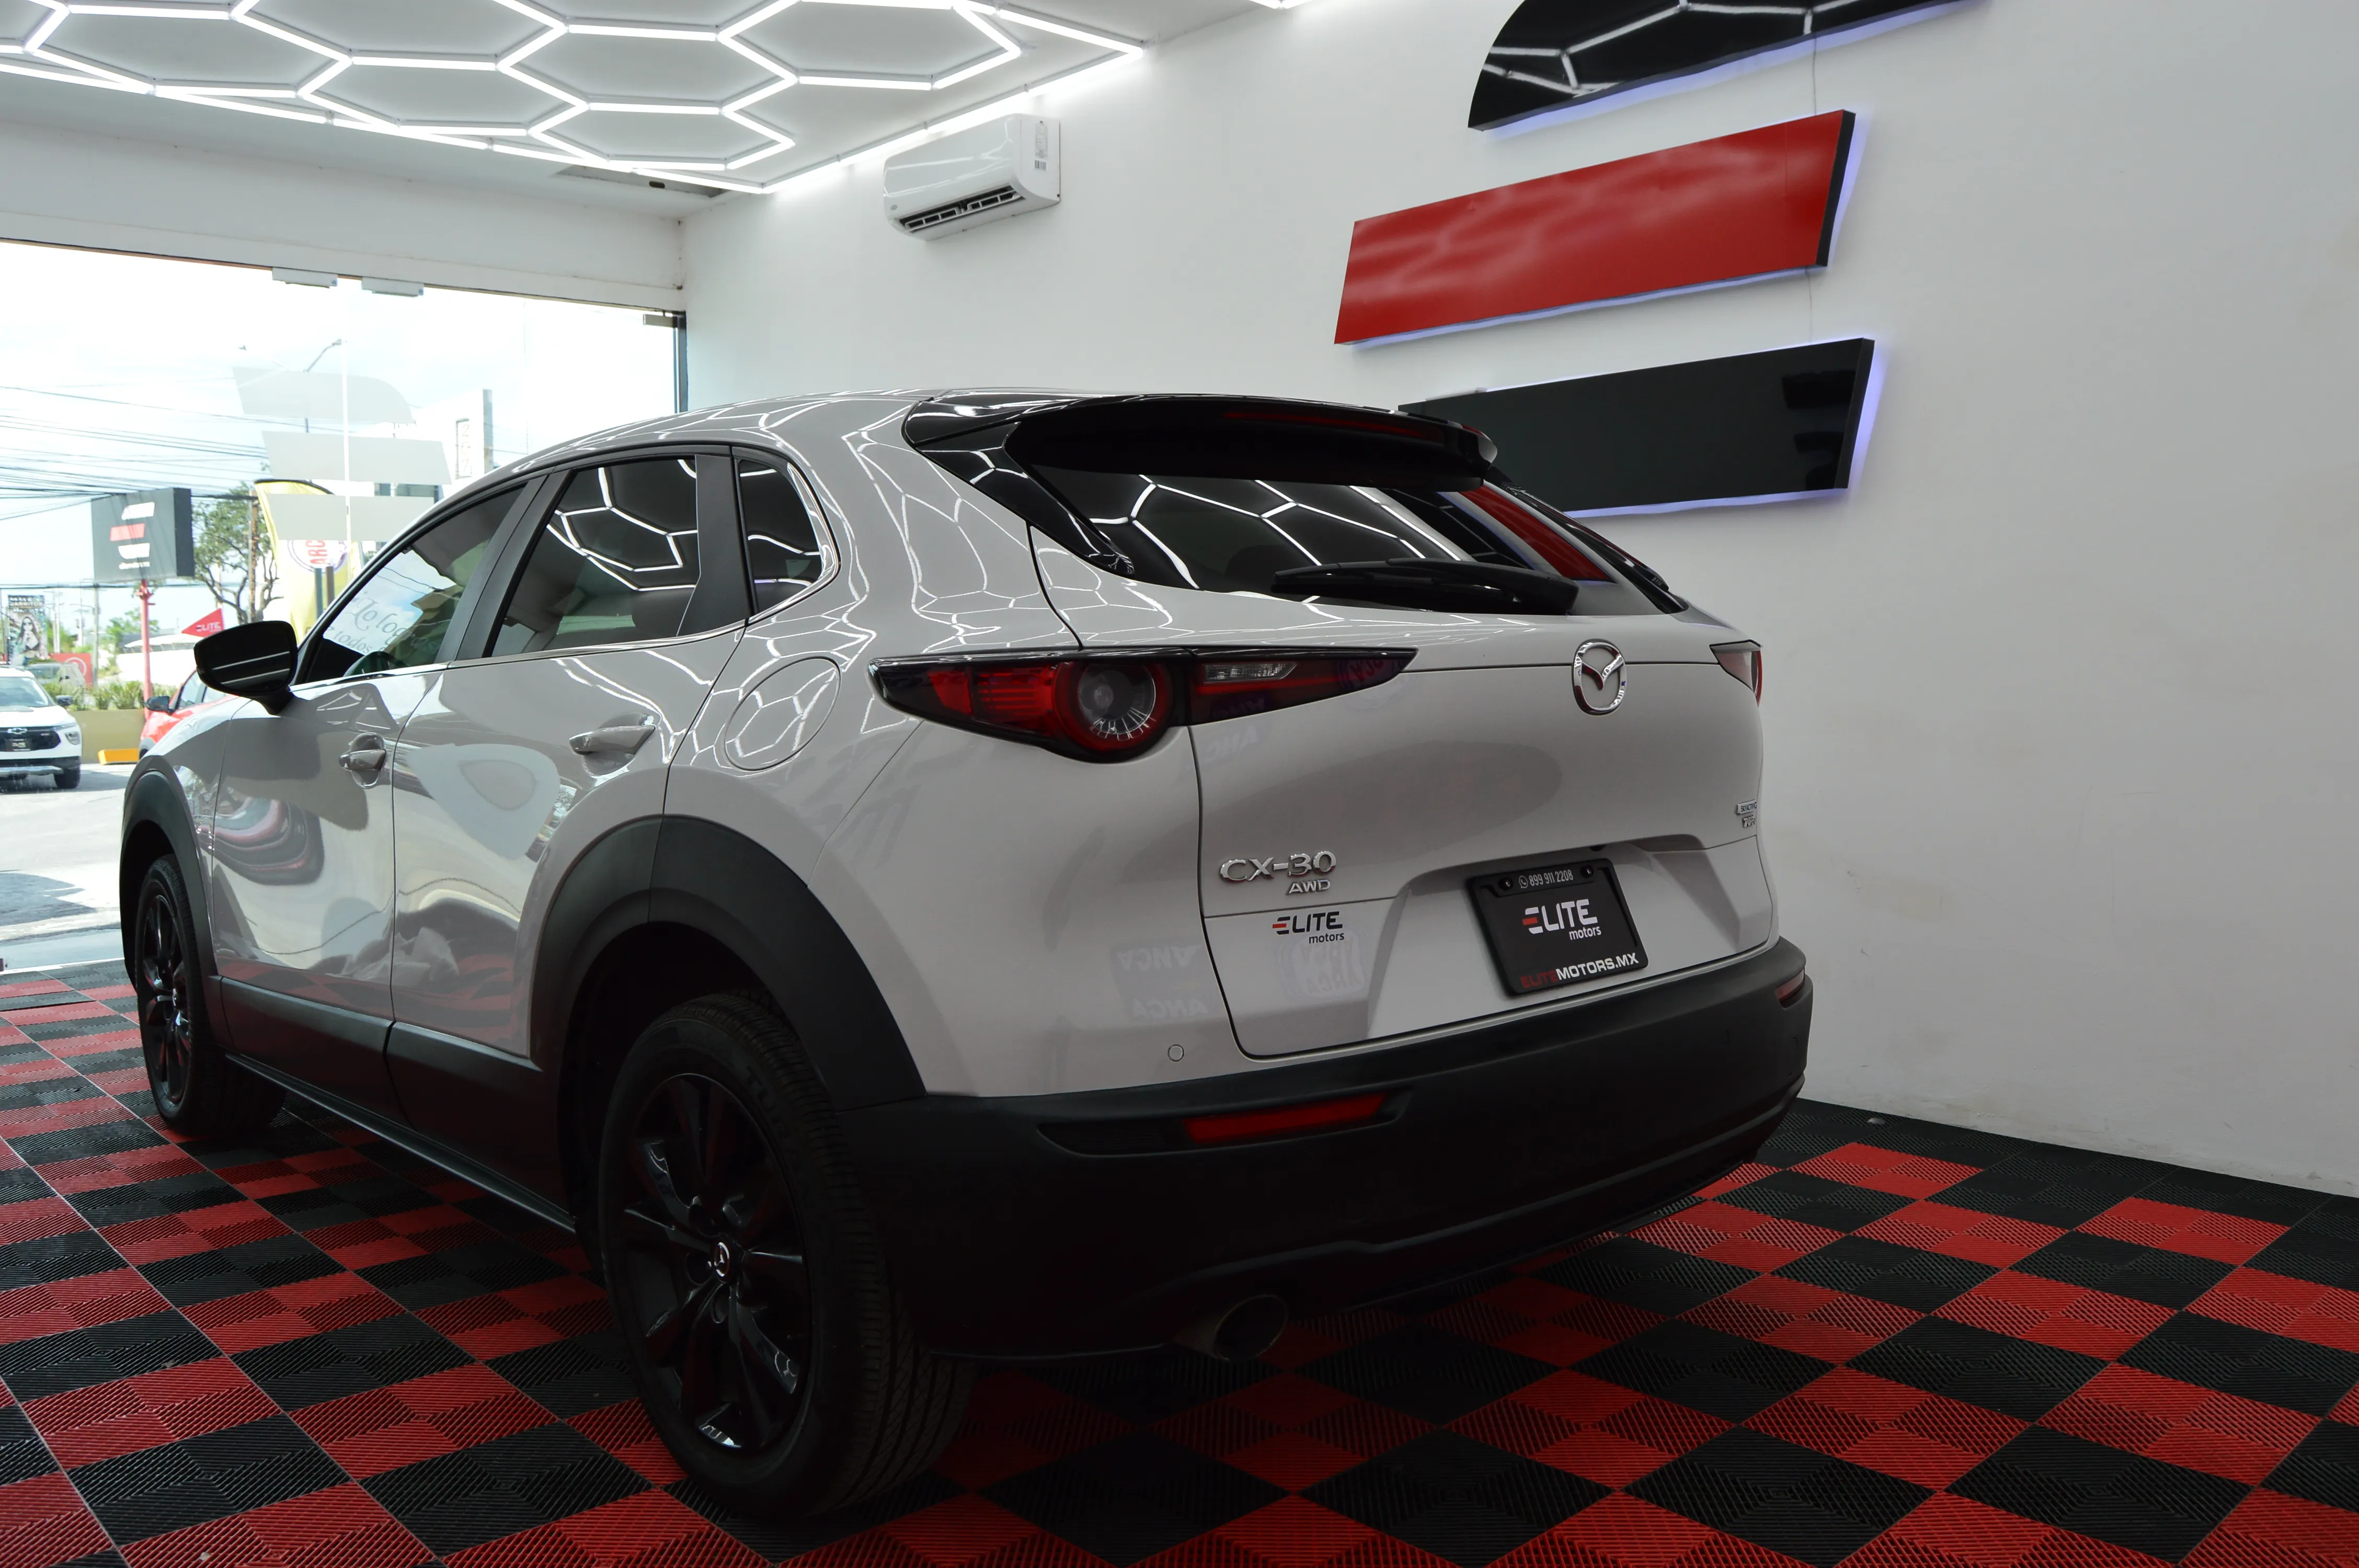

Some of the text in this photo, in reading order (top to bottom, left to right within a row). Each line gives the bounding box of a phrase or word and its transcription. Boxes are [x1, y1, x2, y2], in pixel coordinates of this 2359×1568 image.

[1219, 850, 1337, 883] CX-30
[1286, 879, 1331, 895] AWD
[1529, 870, 1573, 886] 899 911 2208
[1272, 911, 1343, 935] ELITE
[1522, 899, 1598, 934] ELITE
[1309, 932, 1345, 944] motors
[1569, 926, 1601, 940] motors
[1520, 952, 1639, 988] ELITEMOTORS.MX
